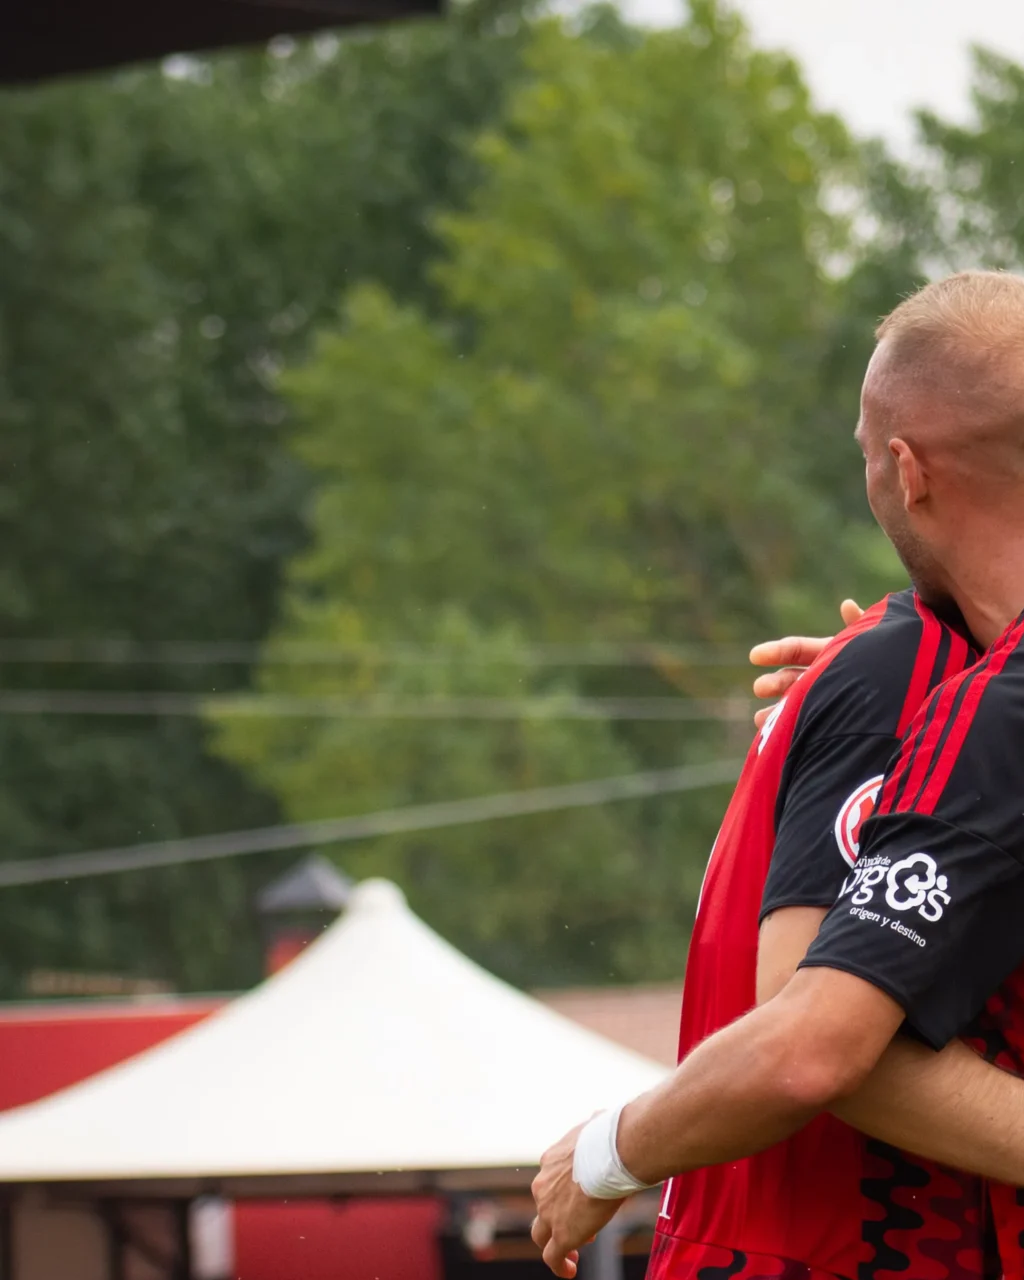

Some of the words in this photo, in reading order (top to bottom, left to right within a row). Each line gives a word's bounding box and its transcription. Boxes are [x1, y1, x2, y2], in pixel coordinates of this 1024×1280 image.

[849, 906, 880, 921] origen
[880, 916, 891, 927] y
[890, 920, 926, 947] destino
